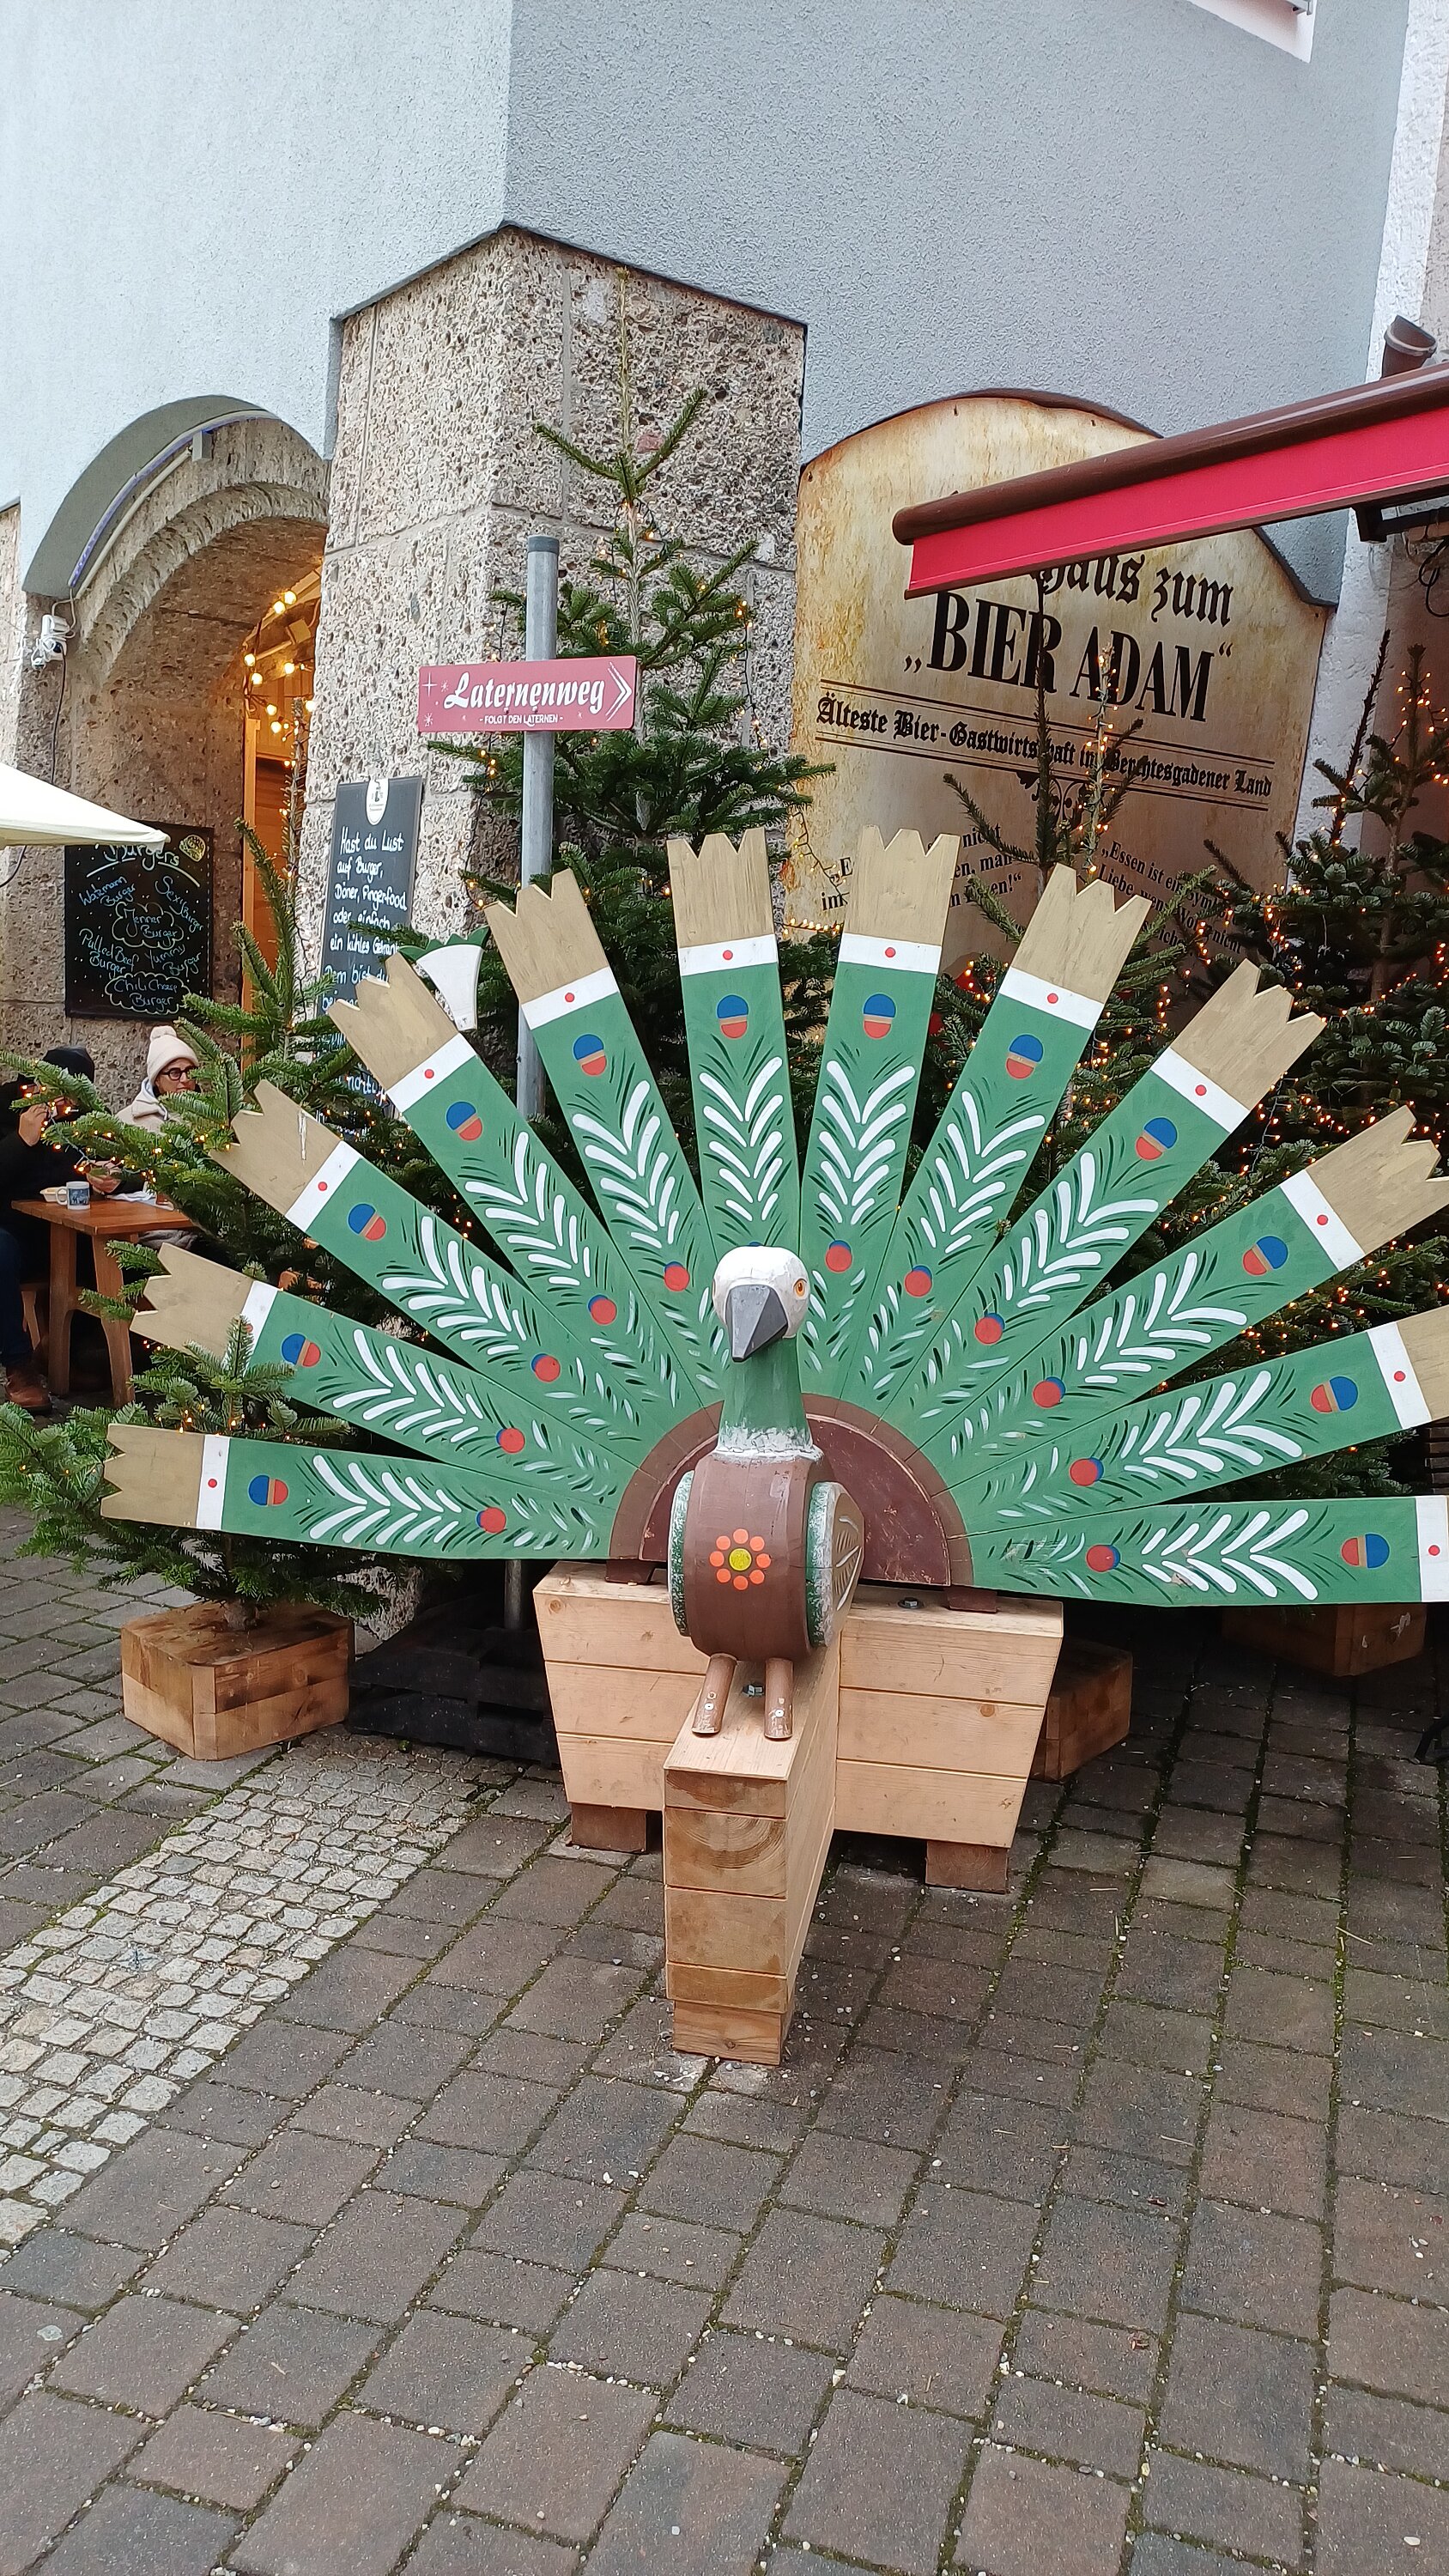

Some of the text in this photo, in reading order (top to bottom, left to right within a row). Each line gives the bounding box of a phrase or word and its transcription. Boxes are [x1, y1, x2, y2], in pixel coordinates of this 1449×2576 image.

[1151, 567, 1234, 627] zum
[444, 671, 605, 714] Laternenweg
[484, 714, 558, 726] FOLGT DEN LATERNEN
[816, 690, 888, 733] Älteste
[1234, 769, 1272, 797] Land
[340, 826, 405, 855] Hast du Lust
[336, 856, 353, 880] auf
[1148, 862, 1165, 884] ist
[333, 906, 352, 925] oder
[330, 933, 343, 951] ein
